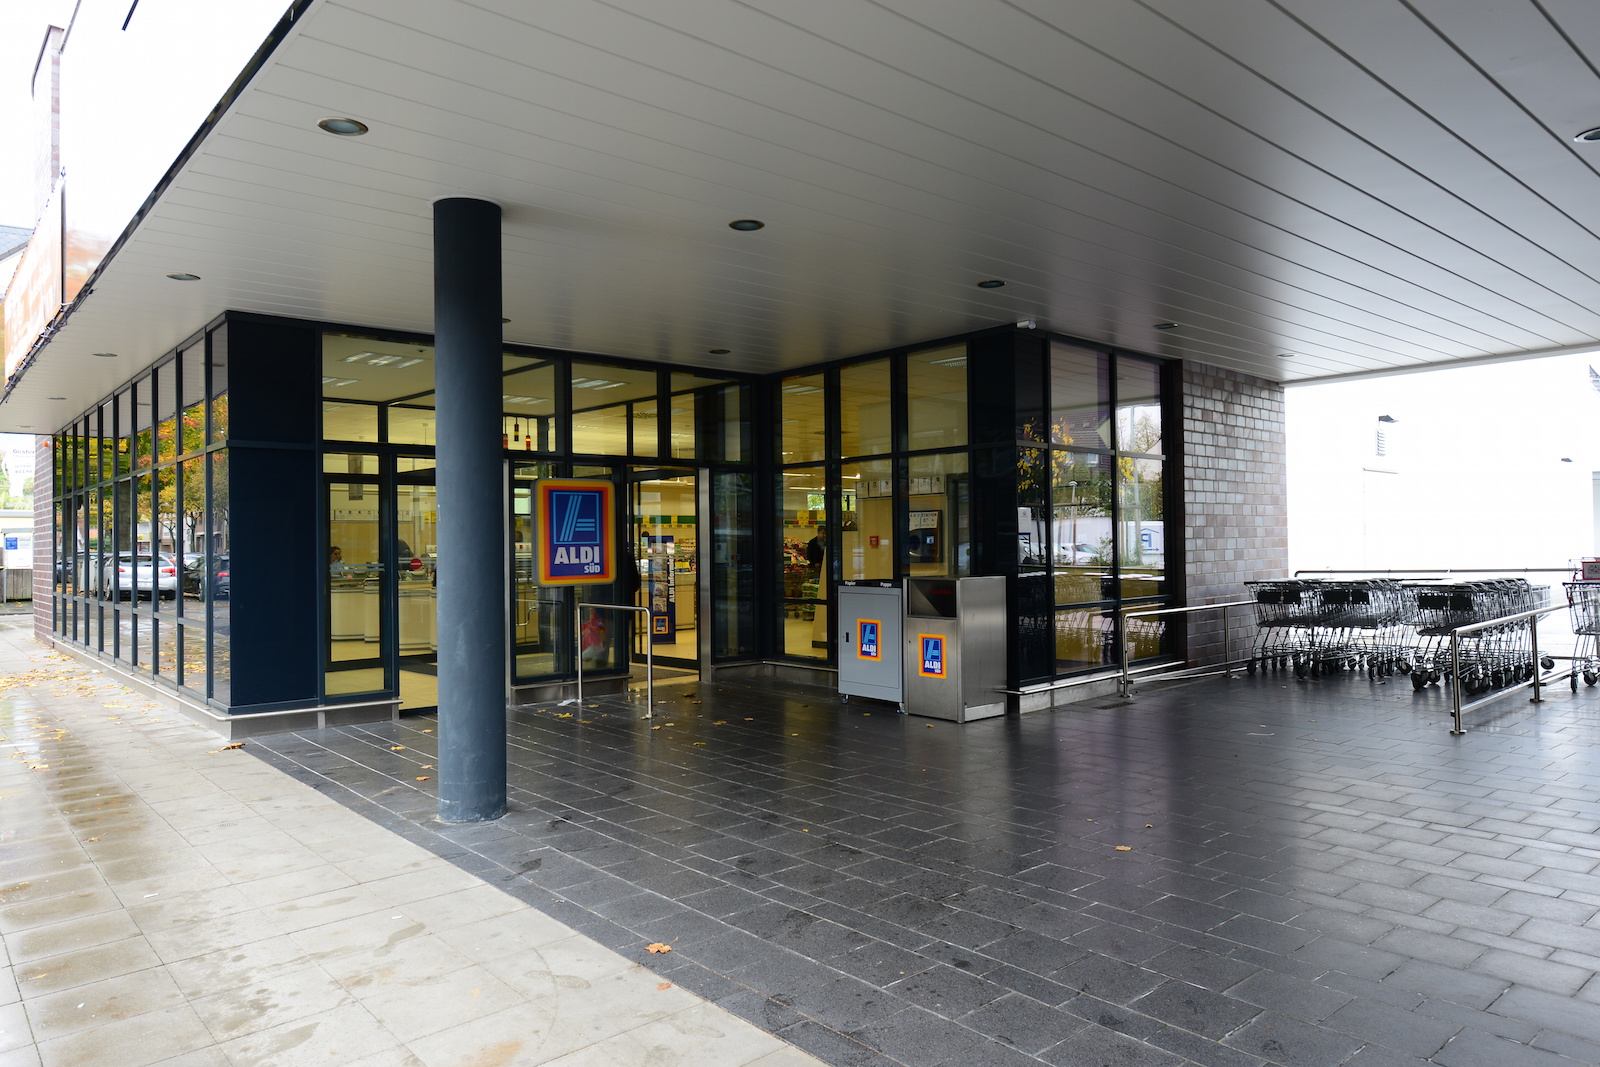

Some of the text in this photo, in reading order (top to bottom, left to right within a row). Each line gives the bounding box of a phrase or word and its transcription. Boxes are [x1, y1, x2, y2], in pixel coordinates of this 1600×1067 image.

[554, 546, 600, 564] ALDI
[584, 563, 600, 573] SÜD
[862, 644, 876, 653] ALDI
[924, 660, 941, 669] ALDI
